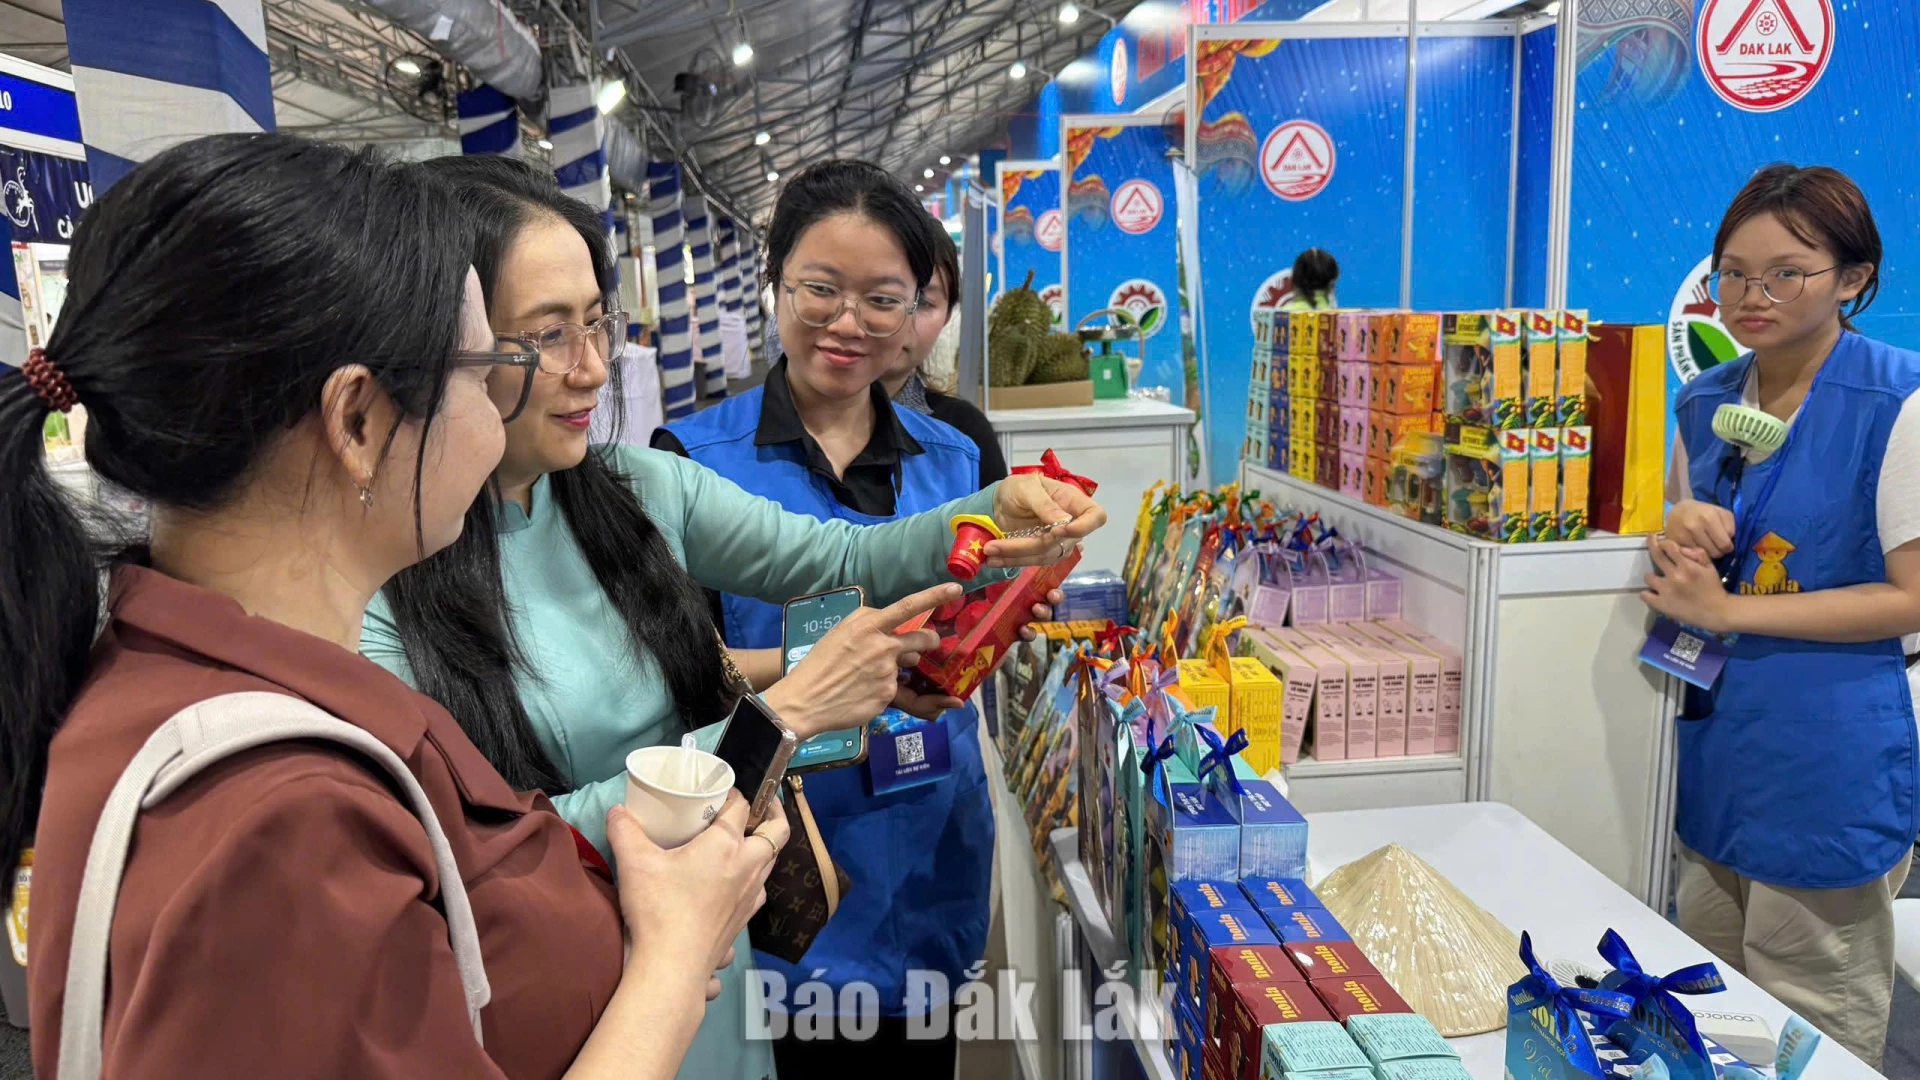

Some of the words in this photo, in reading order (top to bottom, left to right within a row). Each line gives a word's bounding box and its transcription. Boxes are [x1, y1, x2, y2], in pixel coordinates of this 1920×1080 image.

[1740, 43, 1764, 55] DAK
[1768, 43, 1792, 55] LAK
[802, 615, 842, 634] 10:52
[1197, 883, 1224, 908] nonla
[1266, 881, 1294, 906] nonla
[1218, 914, 1247, 941] nonla
[1291, 912, 1321, 938] nonla
[1239, 949, 1270, 979] nonla
[1314, 945, 1347, 974] nonla
[1265, 986, 1299, 1019] nonla
[1344, 980, 1379, 1013] nonla
